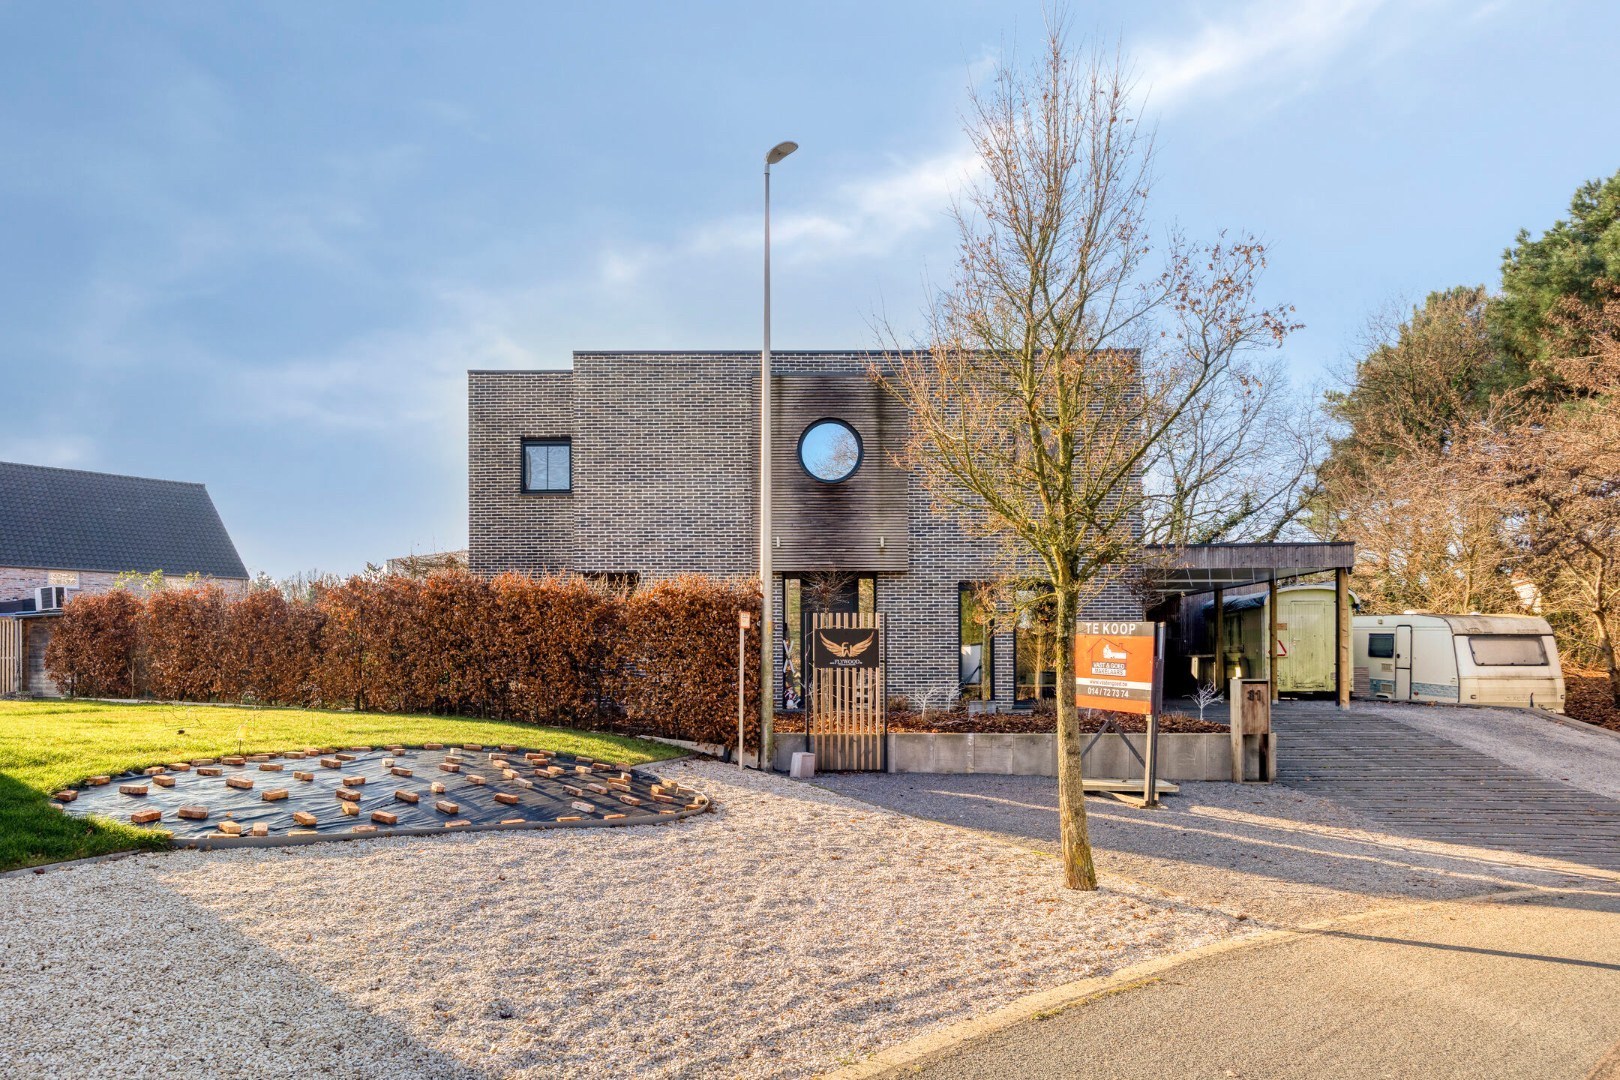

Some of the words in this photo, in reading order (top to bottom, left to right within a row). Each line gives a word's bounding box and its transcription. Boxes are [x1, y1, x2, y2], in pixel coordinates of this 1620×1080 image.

[1085, 622, 1099, 635] TE
[1102, 622, 1136, 635] KOOP
[1112, 689, 1120, 698] 73
[1121, 689, 1129, 698] 74
